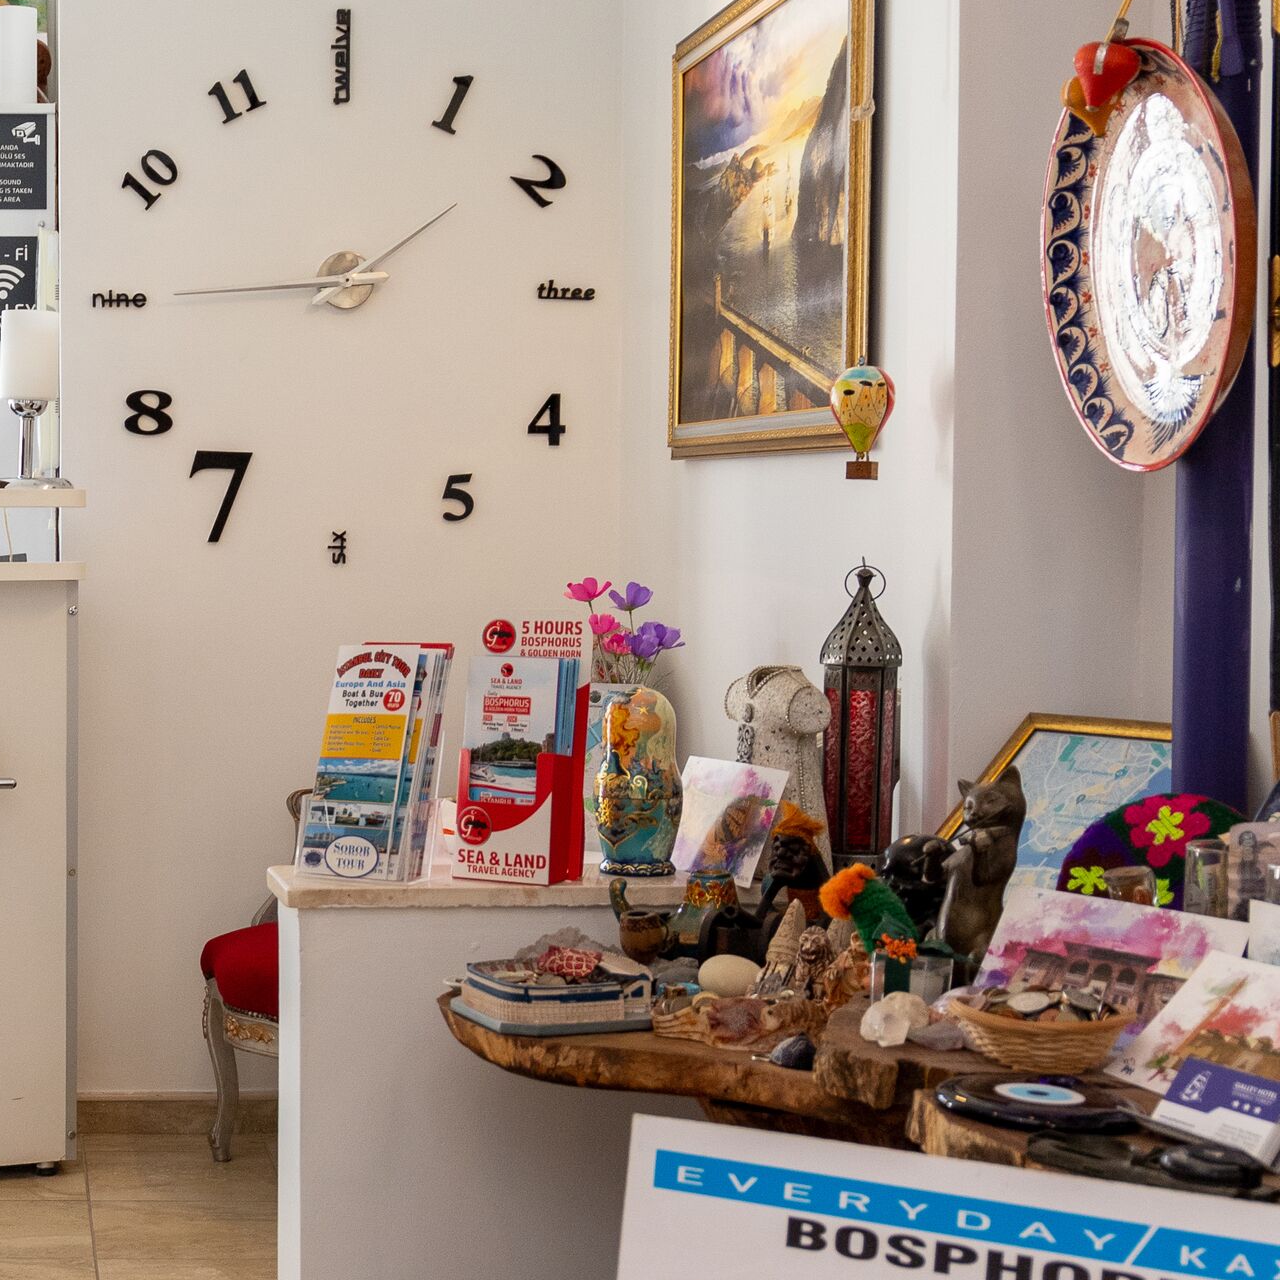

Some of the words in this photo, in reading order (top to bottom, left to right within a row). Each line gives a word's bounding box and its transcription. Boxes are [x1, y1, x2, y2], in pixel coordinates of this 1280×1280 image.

[330, 8, 352, 106] twelve
[207, 69, 268, 125] 11
[431, 74, 475, 136] 1
[14, 152, 26, 160] SES
[121, 149, 179, 211] 10
[509, 154, 567, 208] 2
[92, 289, 147, 310] nine
[537, 279, 596, 301] three
[124, 389, 174, 437] 8
[527, 392, 566, 446] 4
[189, 450, 253, 544] 7
[442, 472, 475, 523] 5
[330, 531, 347, 564] six
[522, 621, 530, 634] 5
[534, 621, 582, 635] HOURS
[521, 636, 582, 648] BOSPHORUS
[520, 649, 526, 657] &
[528, 649, 558, 658] GOLDEN
[560, 650, 582, 658] HORN
[335, 681, 365, 689] Europe
[366, 680, 384, 688] And
[342, 690, 360, 698] Boat
[369, 690, 384, 698] Bus
[345, 700, 379, 708] Together
[388, 691, 402, 702] 70
[484, 698, 530, 708] BOSPHORUS
[458, 848, 485, 864] SEA
[489, 851, 500, 866] &
[504, 853, 547, 869] LAND
[467, 864, 499, 875] TRAVEL
[501, 868, 536, 878] AGENCY
[677, 1165, 1117, 1251] EVERYDAY
